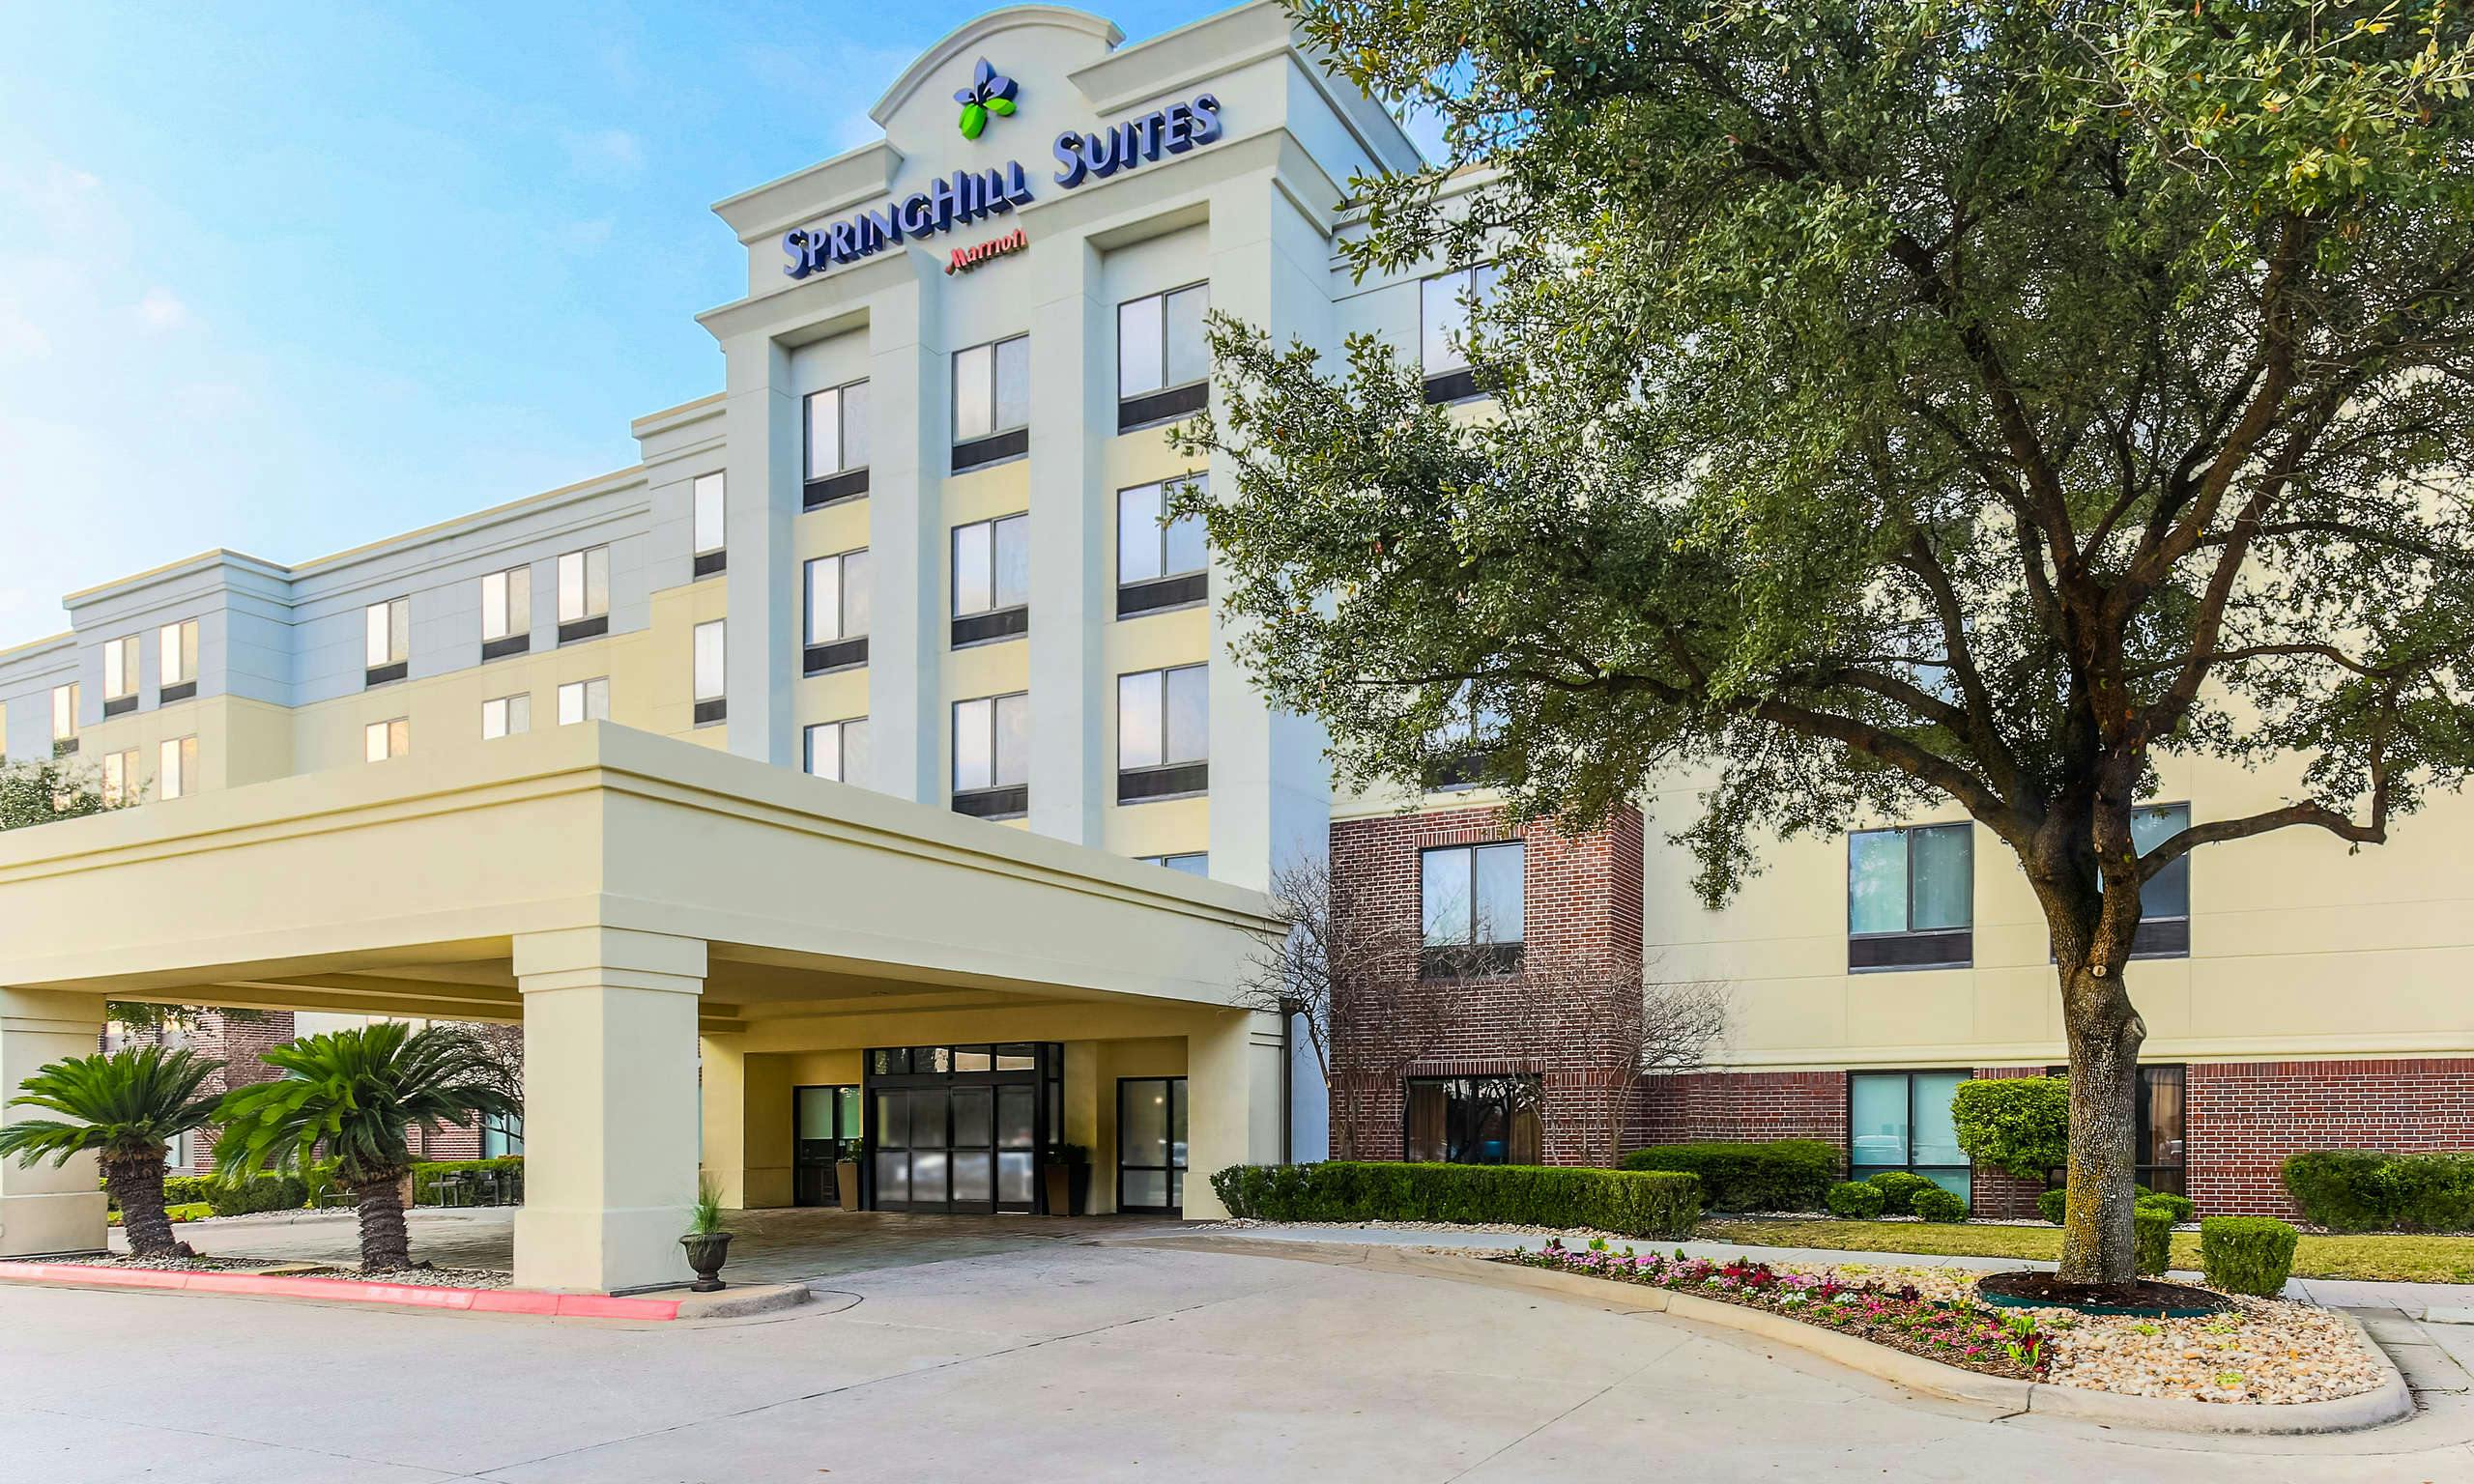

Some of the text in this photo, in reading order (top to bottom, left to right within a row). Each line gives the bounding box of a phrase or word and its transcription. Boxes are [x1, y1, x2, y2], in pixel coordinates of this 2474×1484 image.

[784, 94, 1223, 279] SPRINGHILL SUITES
[945, 228, 1028, 275] Marriott
